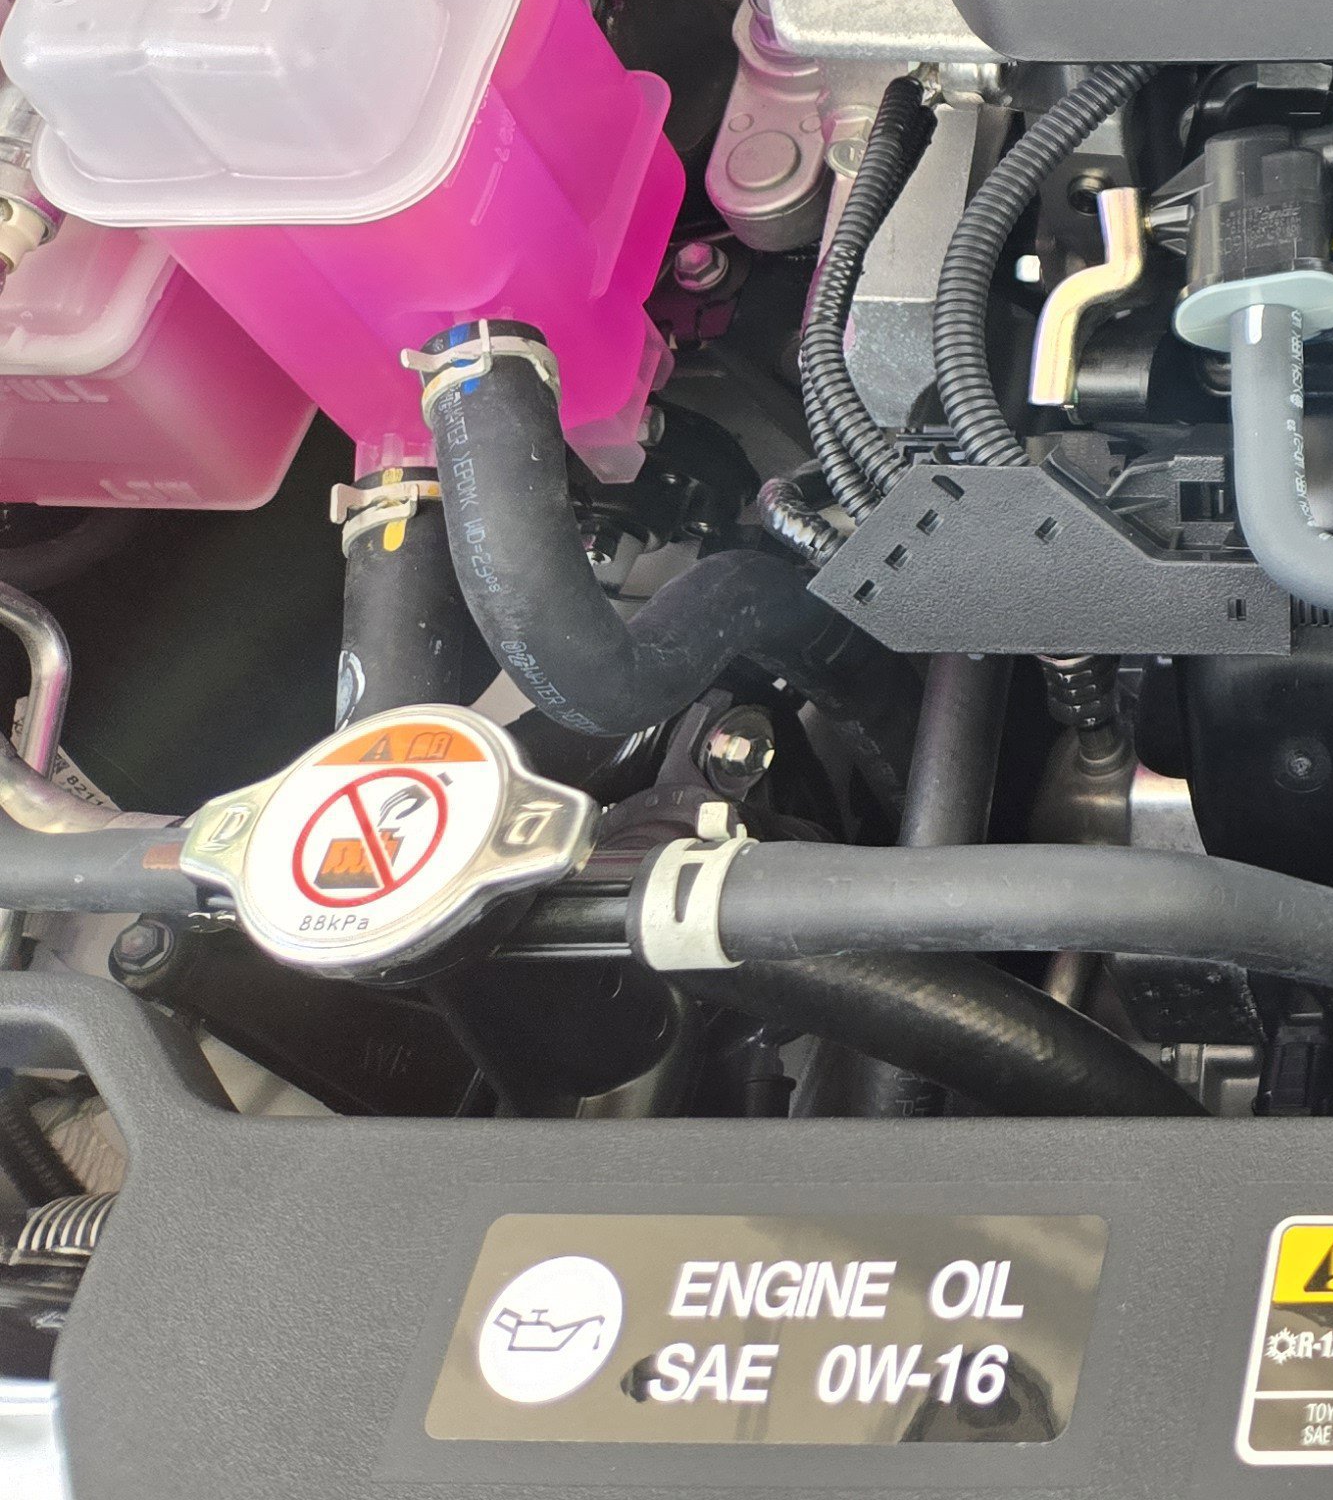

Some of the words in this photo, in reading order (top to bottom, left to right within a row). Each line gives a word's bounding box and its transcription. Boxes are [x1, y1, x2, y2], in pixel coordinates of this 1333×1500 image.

[299, 914, 371, 931] 88kPa
[668, 1259, 899, 1319] ENGINE
[928, 1259, 1025, 1320] OIL
[647, 1342, 780, 1404] SAE
[817, 1342, 1011, 1405] 0W-16
[1303, 1424, 1333, 1445] SAE
